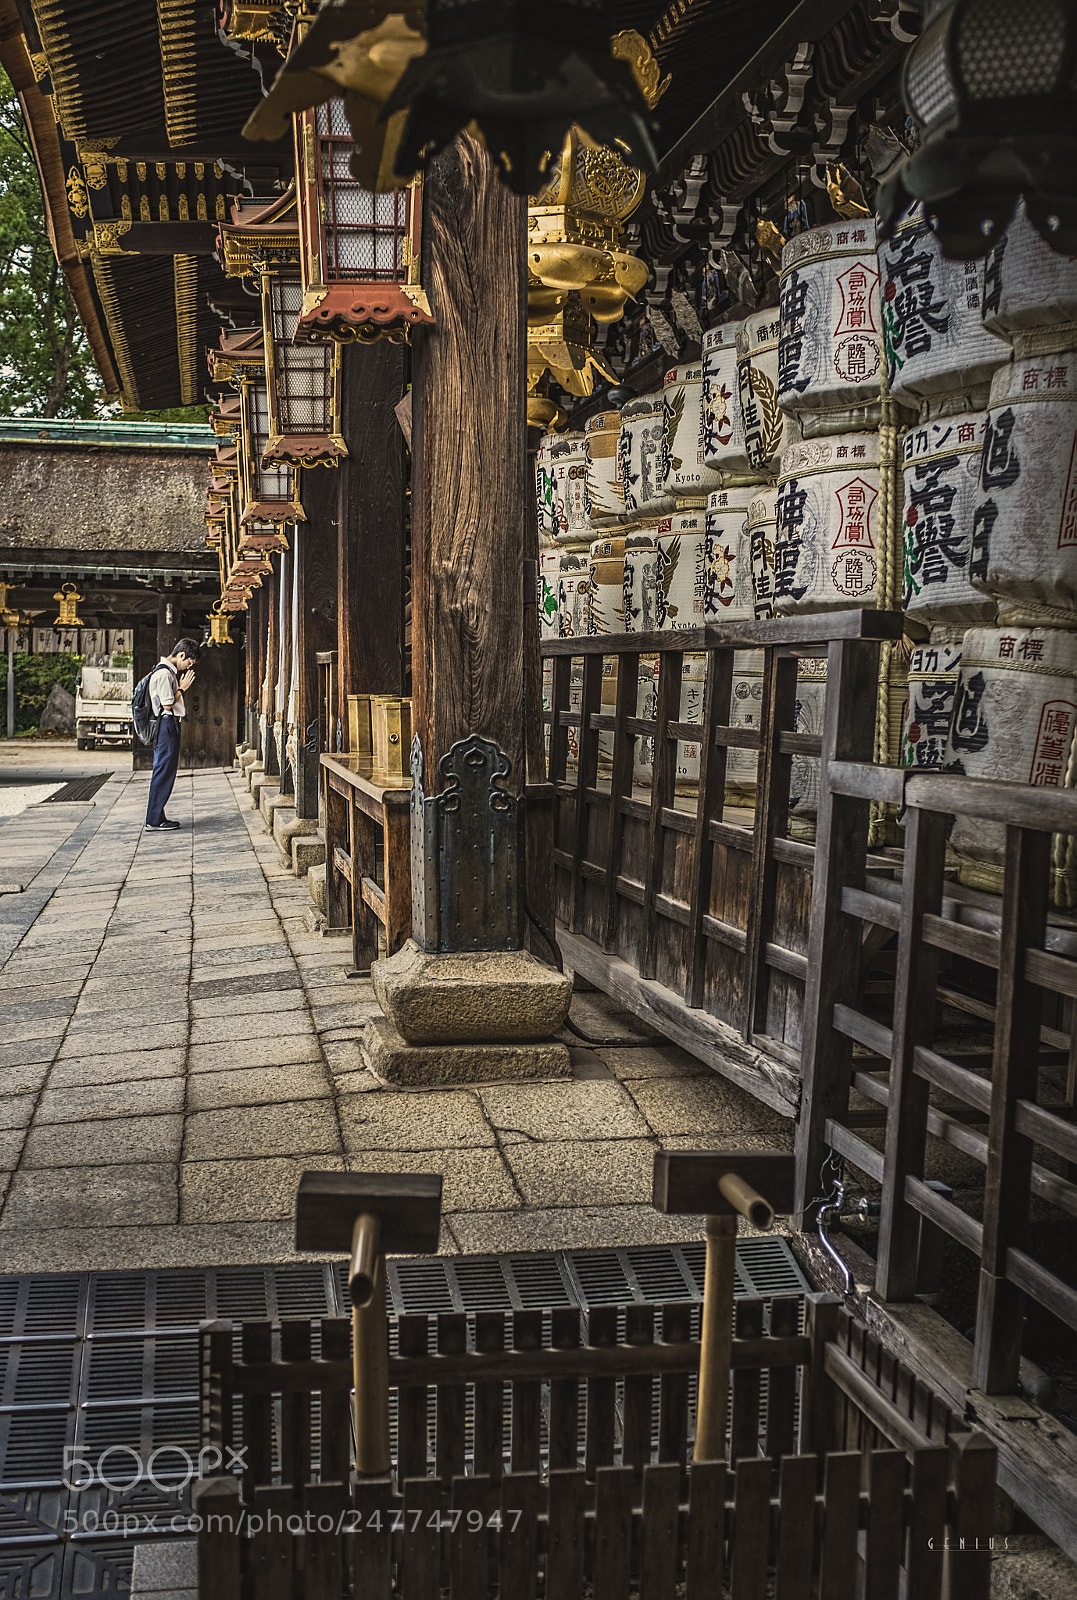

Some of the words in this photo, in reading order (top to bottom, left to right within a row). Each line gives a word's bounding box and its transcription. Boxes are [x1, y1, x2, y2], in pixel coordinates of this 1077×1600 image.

[836, 229, 867, 245] 商標
[1022, 366, 1068, 391] 商標
[836, 445, 867, 459] 商標
[675, 472, 701, 485] Kyoto
[999, 635, 1045, 662] 商標
[687, 688, 699, 724] キンシ
